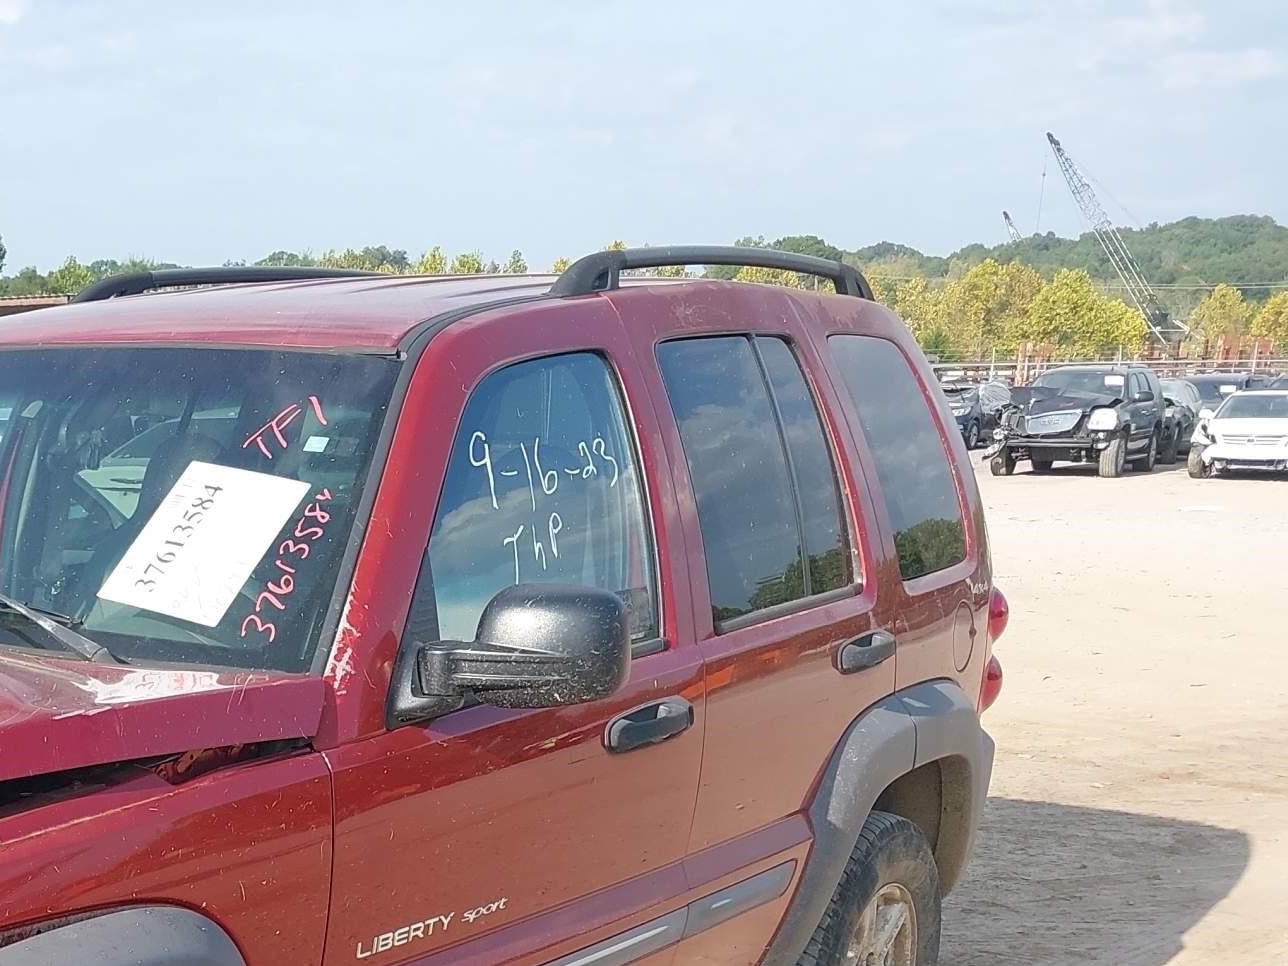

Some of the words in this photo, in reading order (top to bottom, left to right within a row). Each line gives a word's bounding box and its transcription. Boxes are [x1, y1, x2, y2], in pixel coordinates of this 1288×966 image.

[242, 395, 328, 460] TF1
[468, 430, 619, 513] 9-16-23
[133, 483, 224, 593] 37613584
[355, 911, 455, 960] LIBERTY
[461, 896, 508, 923] sport
